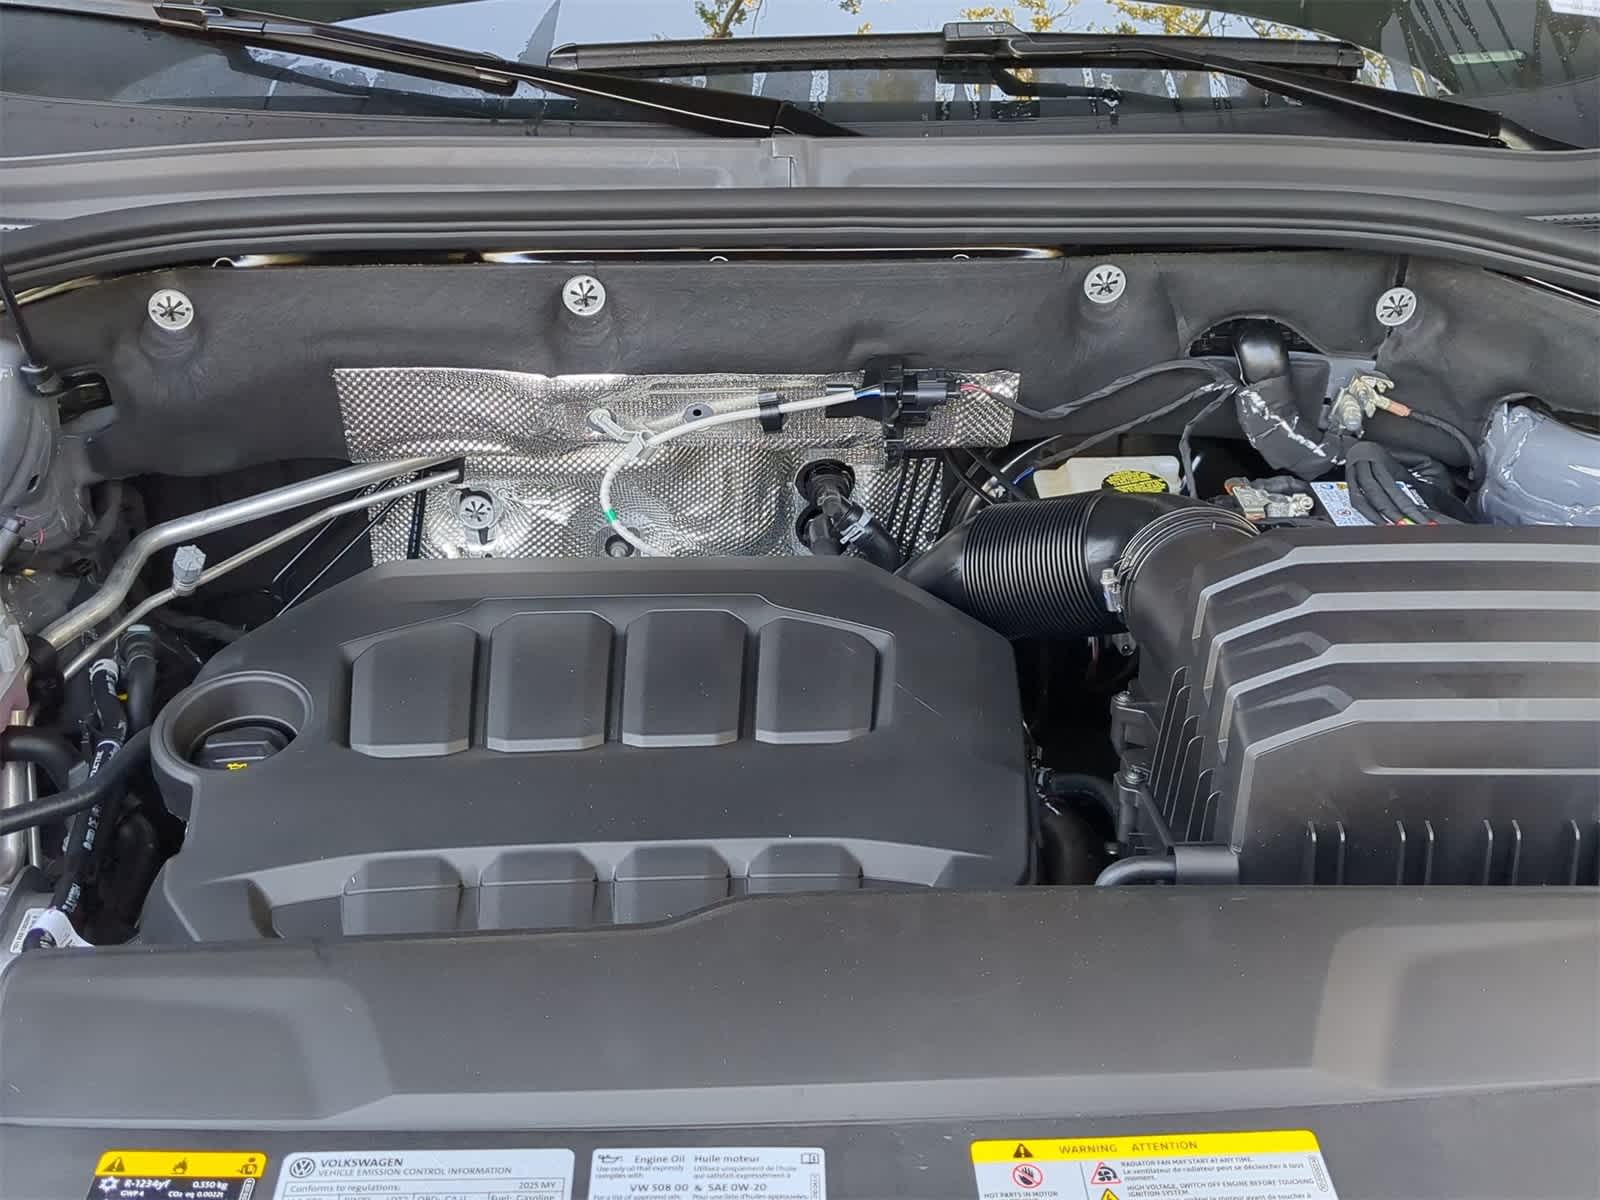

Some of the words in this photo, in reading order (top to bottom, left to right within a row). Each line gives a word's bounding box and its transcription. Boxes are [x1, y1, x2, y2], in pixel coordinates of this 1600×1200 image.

[1059, 1143, 1118, 1154] WARNING
[1131, 1140, 1199, 1152] ATTENTION
[320, 1158, 404, 1168] VOLKSWAGEN
[634, 1155, 668, 1165] Engine
[671, 1154, 685, 1163] Oil
[694, 1154, 721, 1163] Huile
[723, 1154, 760, 1163] moteur
[318, 1168, 354, 1177] VEHICLE
[357, 1168, 400, 1176] EMISSION
[403, 1167, 446, 1176] CONTROL
[448, 1166, 512, 1175] INFORMATION
[1183, 1165, 1214, 1173] radiateur
[1216, 1165, 1233, 1173] peut
[217, 1181, 229, 1191] kg
[290, 1184, 334, 1192] Conforms
[519, 1181, 539, 1190] 2025
[541, 1181, 556, 1189] MY
[630, 1183, 649, 1192] VW
[652, 1183, 672, 1192] 508
[674, 1183, 689, 1192] 00
[707, 1183, 728, 1192] SAE
[730, 1183, 768, 1192] 0W-20
